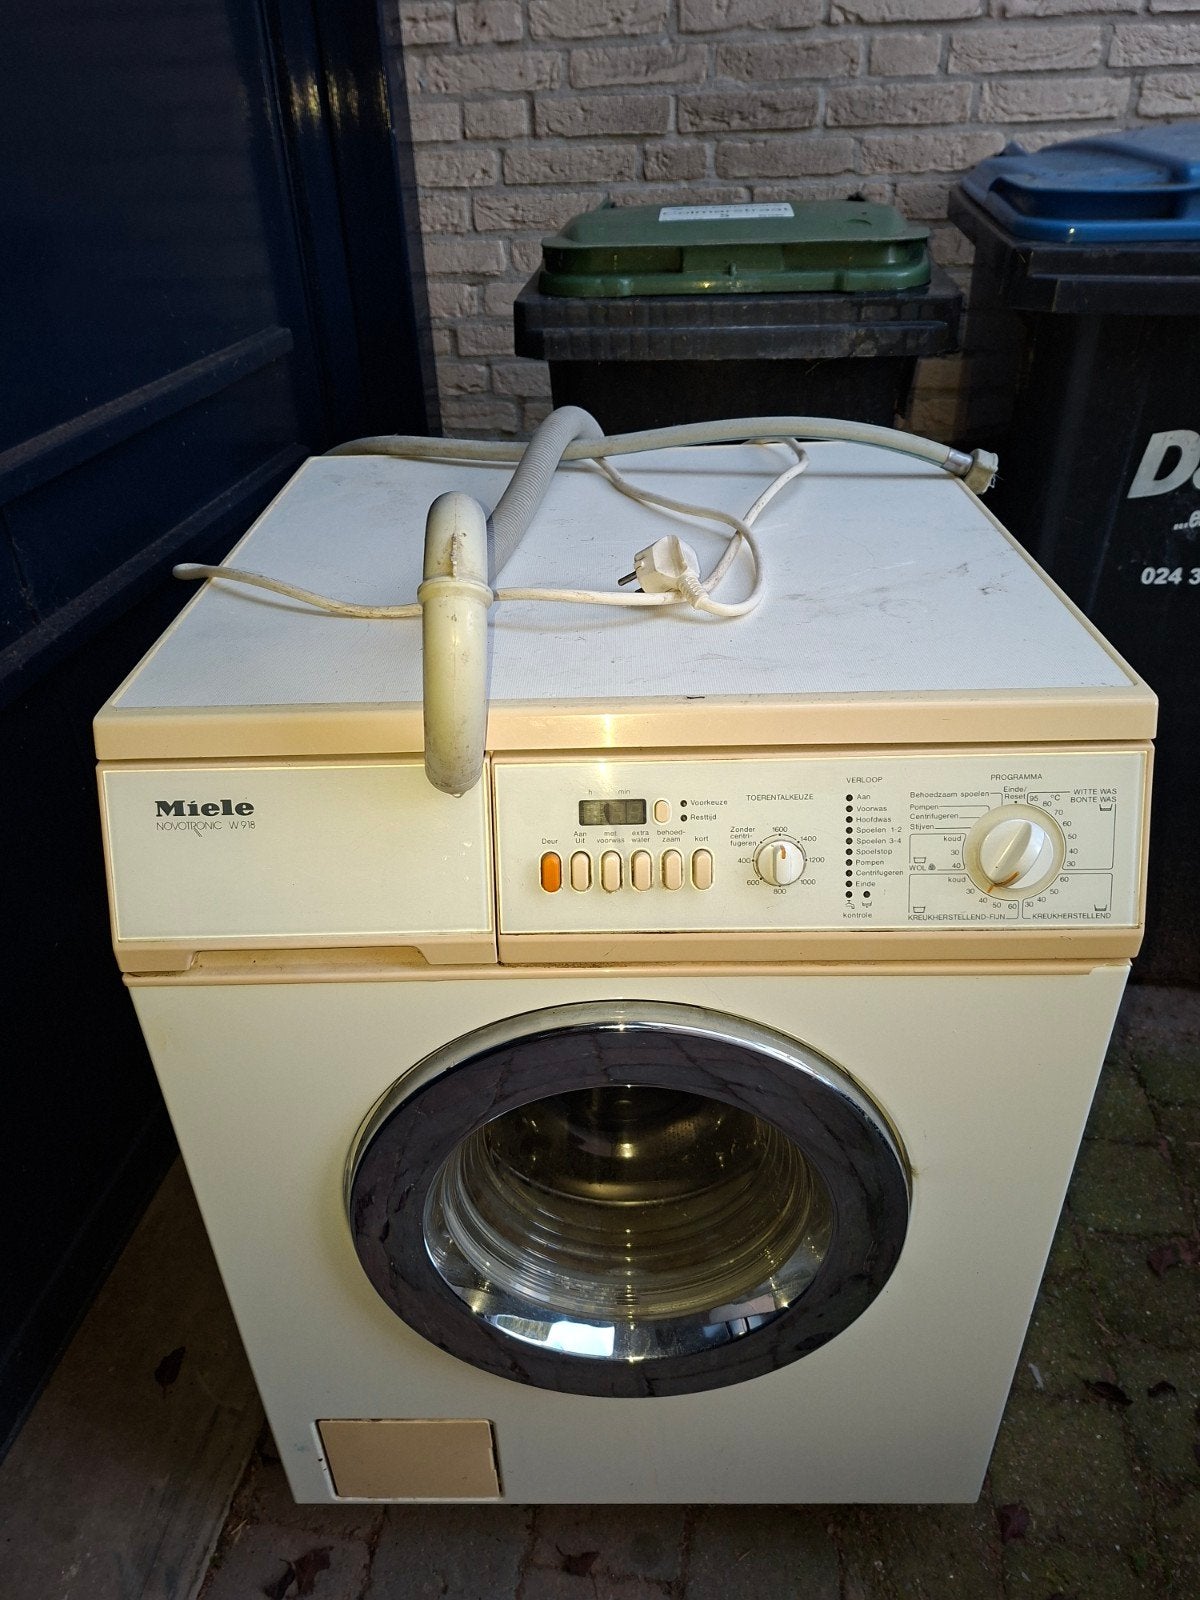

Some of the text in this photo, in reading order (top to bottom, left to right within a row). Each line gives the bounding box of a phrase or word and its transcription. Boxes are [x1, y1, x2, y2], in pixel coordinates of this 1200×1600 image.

[1127, 430, 1200, 499] D
[1141, 567, 1182, 585] 024
[961, 790, 989, 798] spoelen
[155, 799, 254, 817] Miele
[156, 821, 222, 837] NOVOTRONIC
[856, 848, 892, 856] Spoelstop
